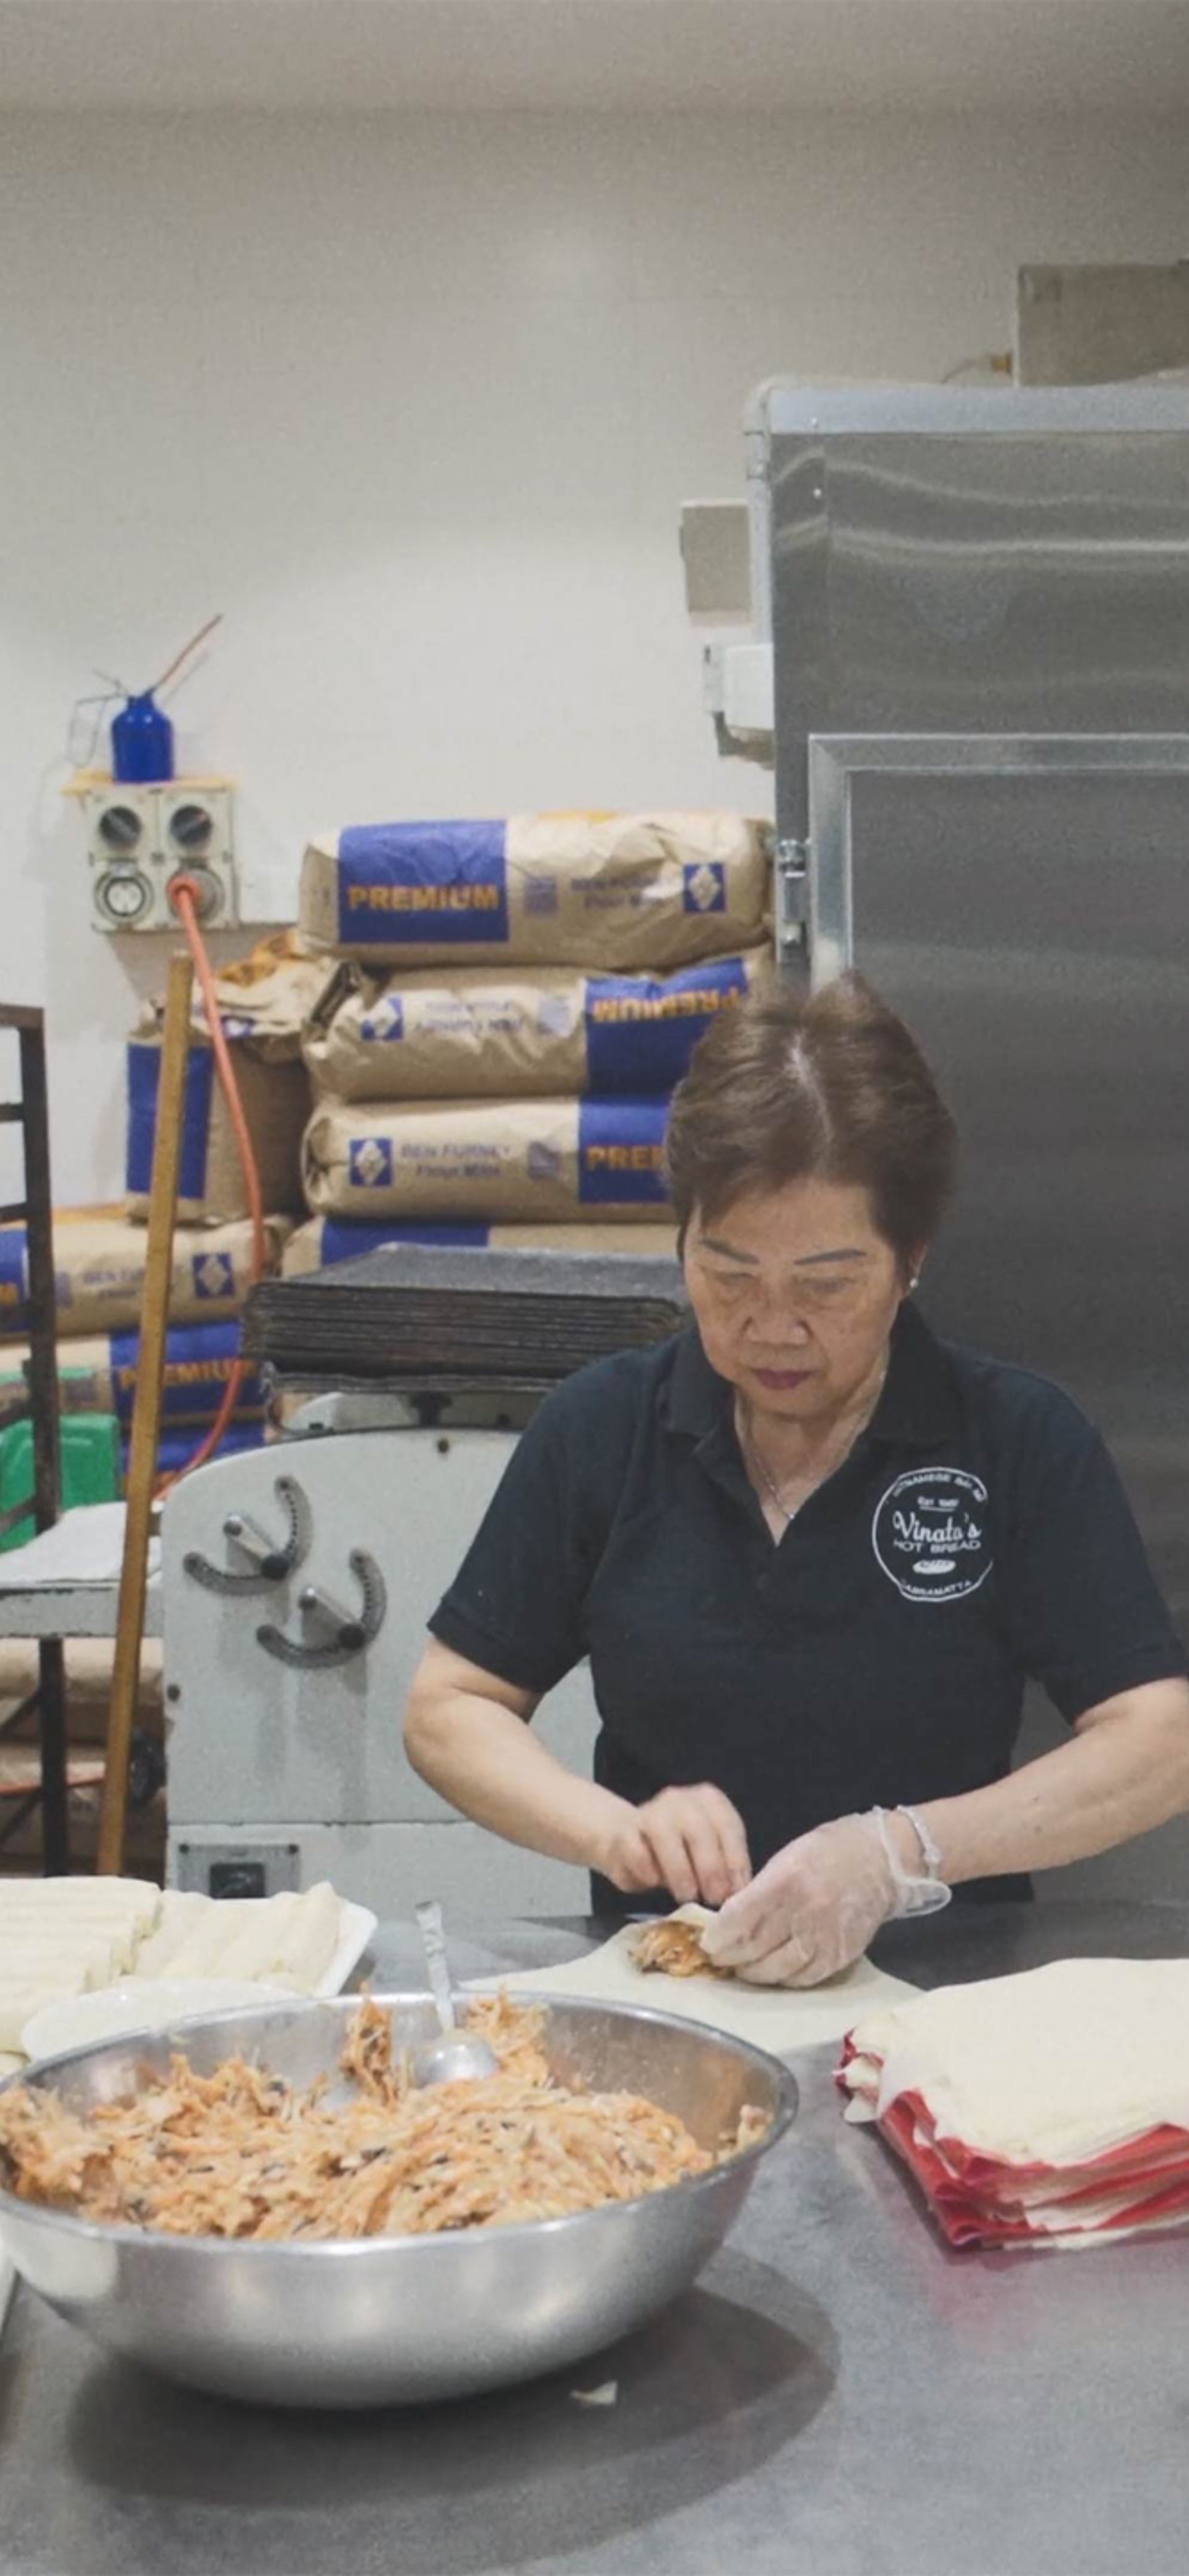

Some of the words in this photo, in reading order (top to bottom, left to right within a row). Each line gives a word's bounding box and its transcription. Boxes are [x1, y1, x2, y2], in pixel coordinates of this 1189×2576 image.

[349, 885, 499, 911] PREMIUM
[593, 986, 738, 1022] PREMIUM
[401, 1145, 437, 1158] BEN
[893, 1538, 923, 1553] HOT
[930, 1540, 982, 1554] BREAD
